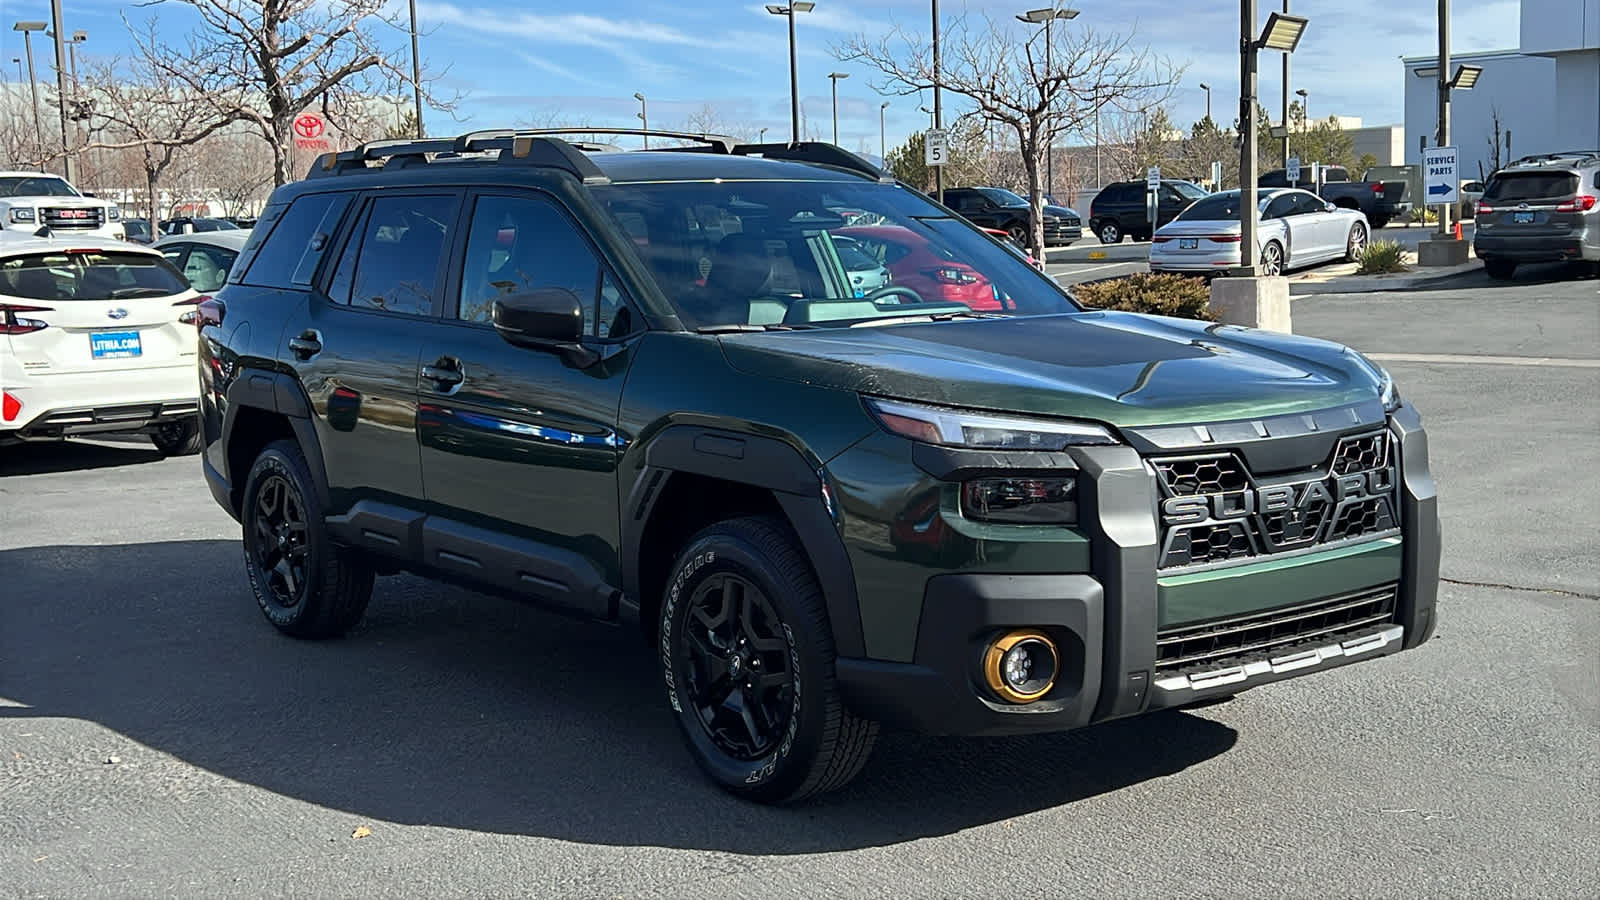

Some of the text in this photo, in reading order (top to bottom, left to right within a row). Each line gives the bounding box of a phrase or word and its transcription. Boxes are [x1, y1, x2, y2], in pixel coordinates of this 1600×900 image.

[295, 139, 329, 150] OYOTA
[933, 148, 941, 160] 5
[1427, 156, 1454, 165] SERVICE
[1430, 167, 1452, 176] PARTS
[60, 210, 88, 218] GMC
[92, 337, 140, 351] LITHIA.COM
[1162, 466, 1395, 525] SUBARU
[662, 551, 717, 713] BRIDGESTONE
